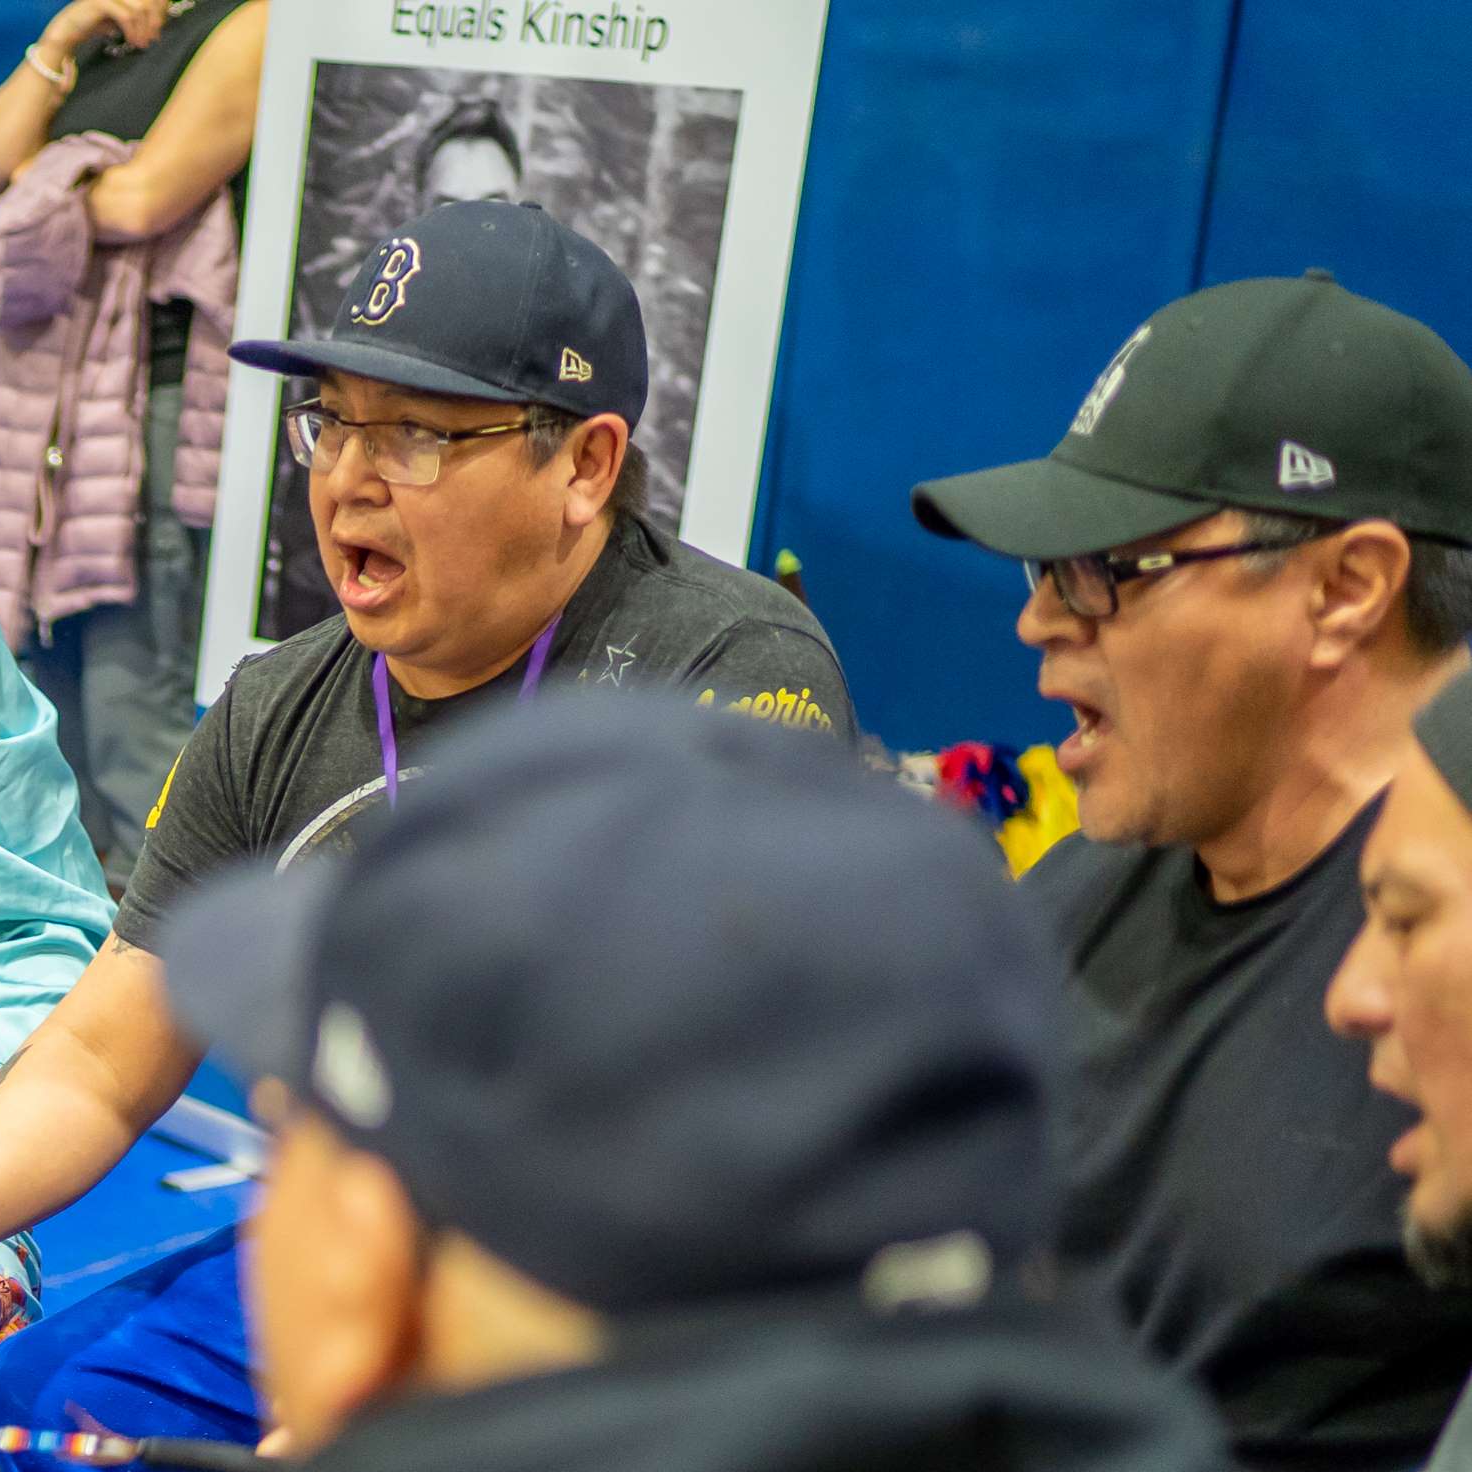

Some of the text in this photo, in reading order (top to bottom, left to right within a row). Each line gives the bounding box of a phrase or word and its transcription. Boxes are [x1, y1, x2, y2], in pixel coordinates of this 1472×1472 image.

[391, 0, 670, 62] Equals Kinship
[350, 238, 421, 325] B
